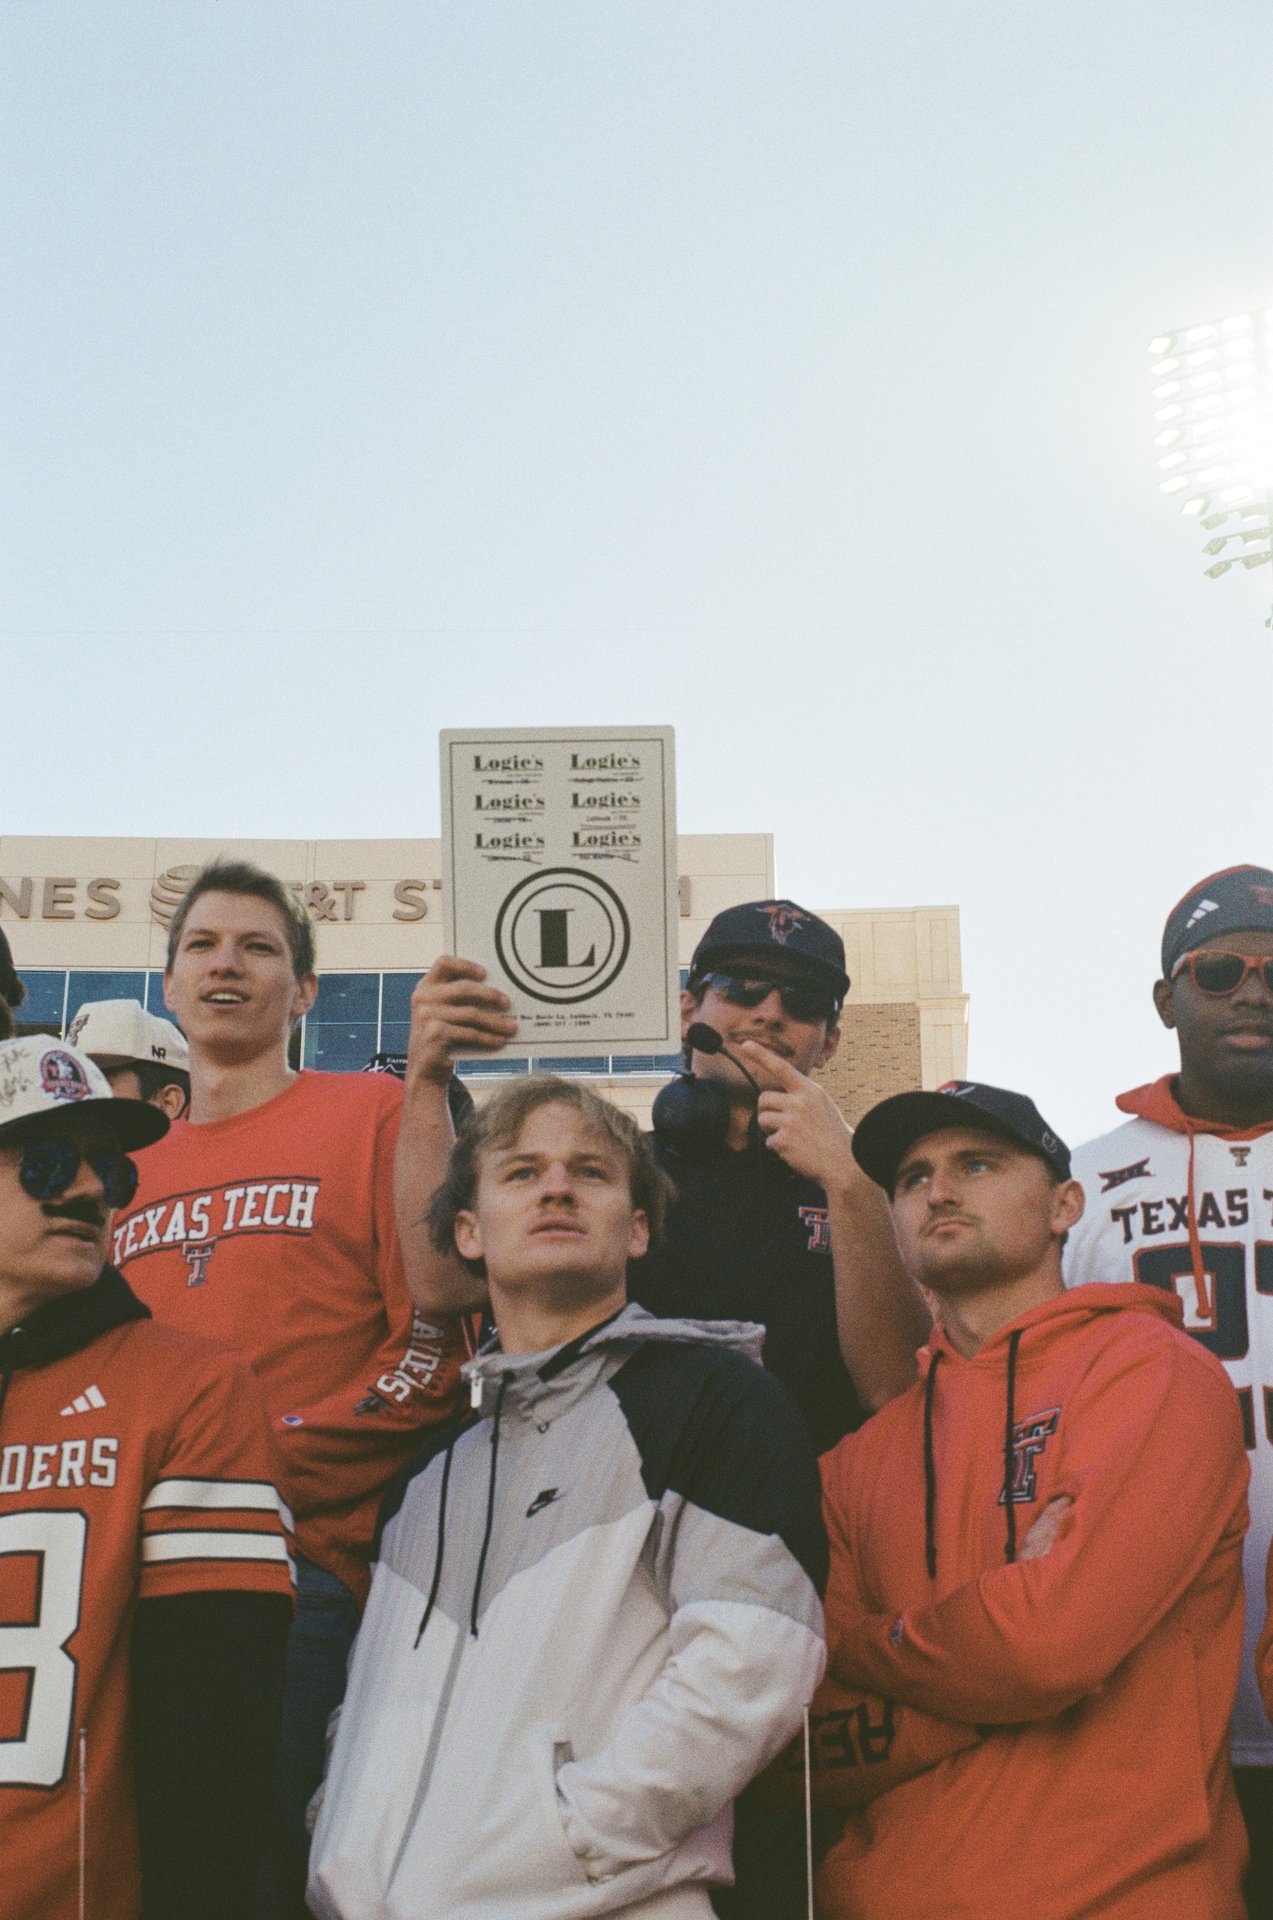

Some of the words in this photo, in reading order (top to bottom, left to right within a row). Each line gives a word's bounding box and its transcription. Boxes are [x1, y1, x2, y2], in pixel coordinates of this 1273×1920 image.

[473, 754, 543, 772] Logie's
[570, 752, 640, 770] Logie's
[474, 793, 545, 810] Logie's
[570, 791, 640, 808] Logie's
[474, 832, 545, 850] Logie's
[571, 831, 641, 848] Logie's
[533, 908, 595, 968] L
[113, 1195, 213, 1266] TEXAS
[222, 1183, 320, 1232] TECH
[1111, 1188, 1249, 1245] TEXAS
[0, 1437, 118, 1494] DERS
